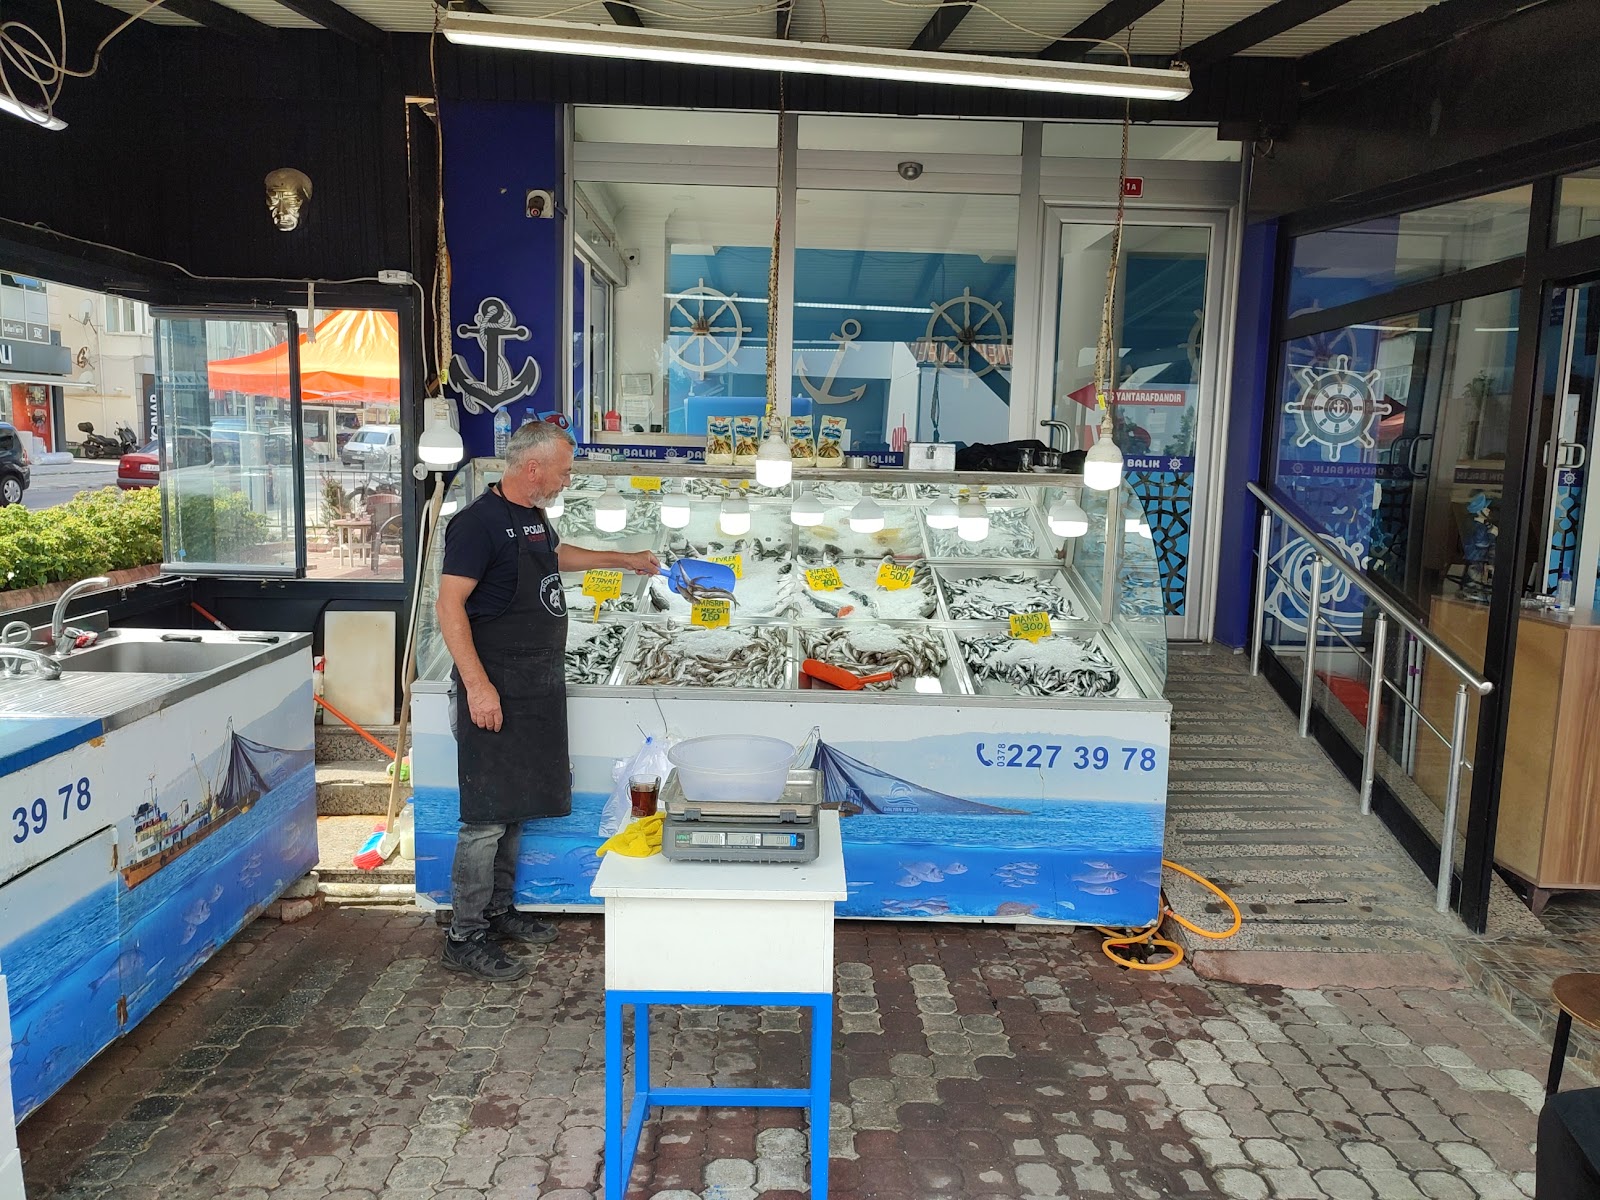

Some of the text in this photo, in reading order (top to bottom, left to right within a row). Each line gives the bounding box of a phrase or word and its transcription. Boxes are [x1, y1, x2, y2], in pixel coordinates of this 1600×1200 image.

[623, 448, 657, 458] BALIK
[1127, 459, 1160, 468] BALIK
[997, 743, 1156, 772] 0378 227 39 78
[12, 776, 92, 844] 39 78
